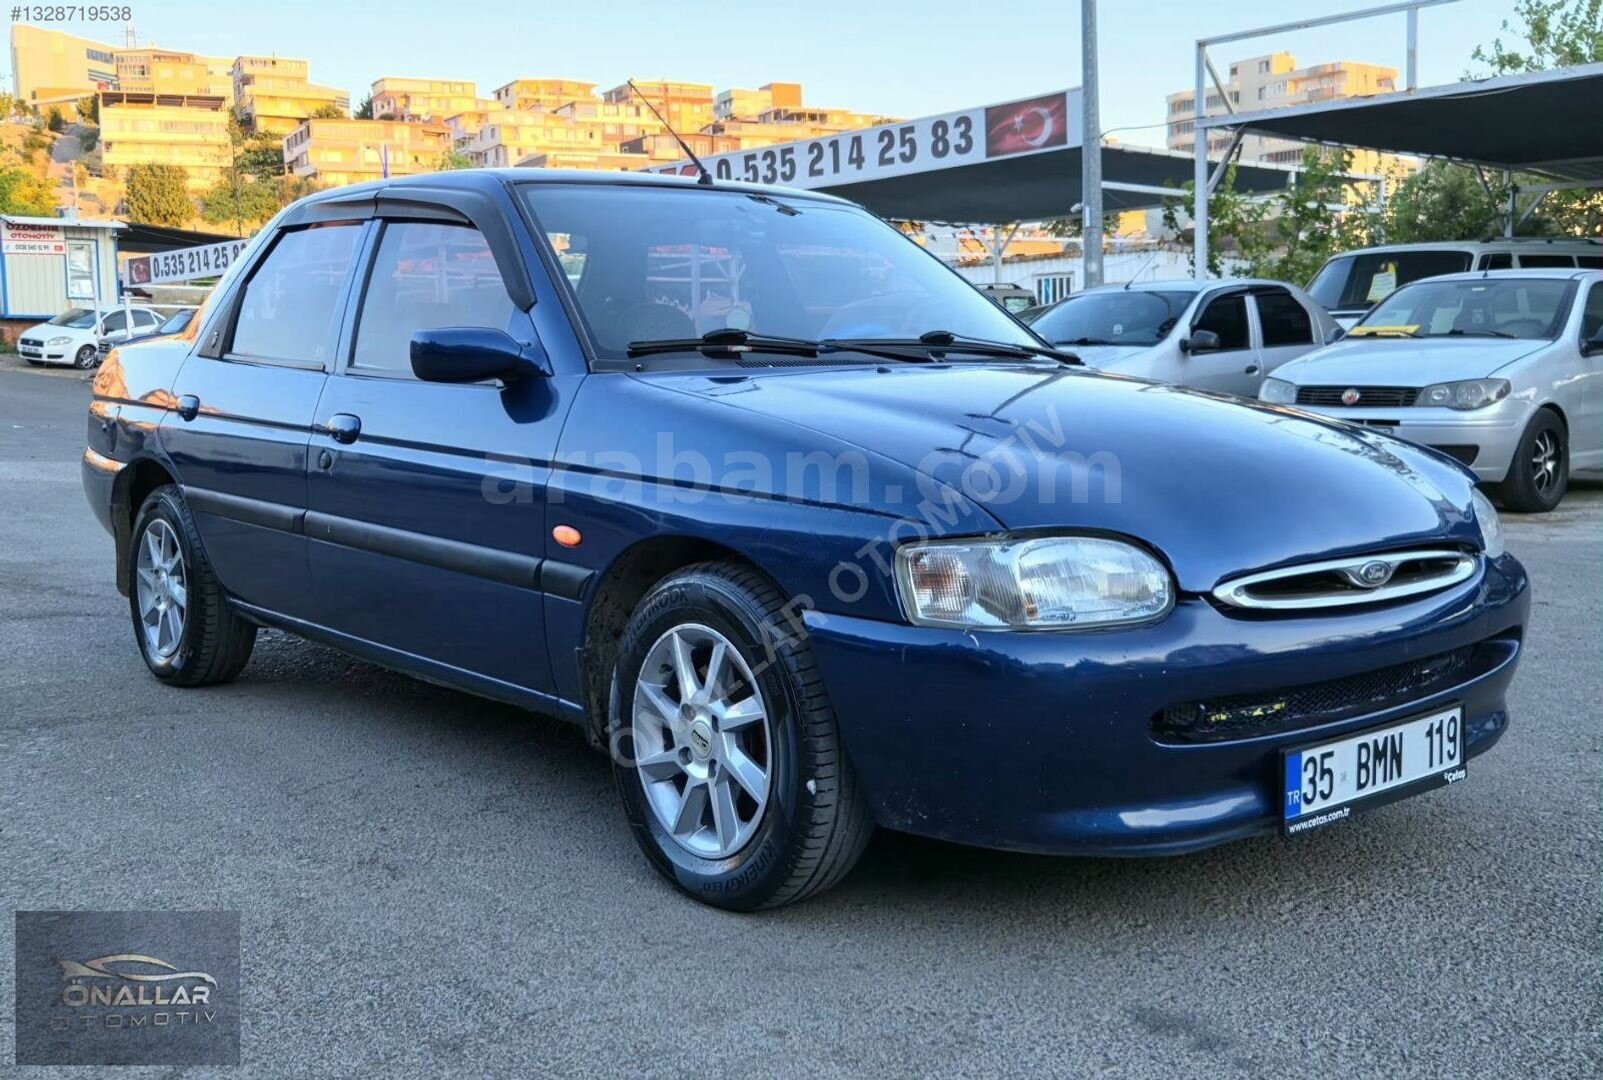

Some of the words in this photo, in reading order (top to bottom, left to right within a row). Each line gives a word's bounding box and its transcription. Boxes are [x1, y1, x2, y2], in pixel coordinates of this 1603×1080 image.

[808, 135, 865, 178] 214
[878, 126, 917, 168] 25
[931, 115, 973, 159] 83
[153, 253, 185, 278] 0.535
[188, 249, 210, 273] 214
[213, 246, 229, 269] 25
[232, 243, 247, 262] 8
[1303, 751, 1334, 805] 35
[1356, 732, 1403, 790] BMN
[1425, 715, 1458, 769] 119
[1287, 790, 1300, 805] TR
